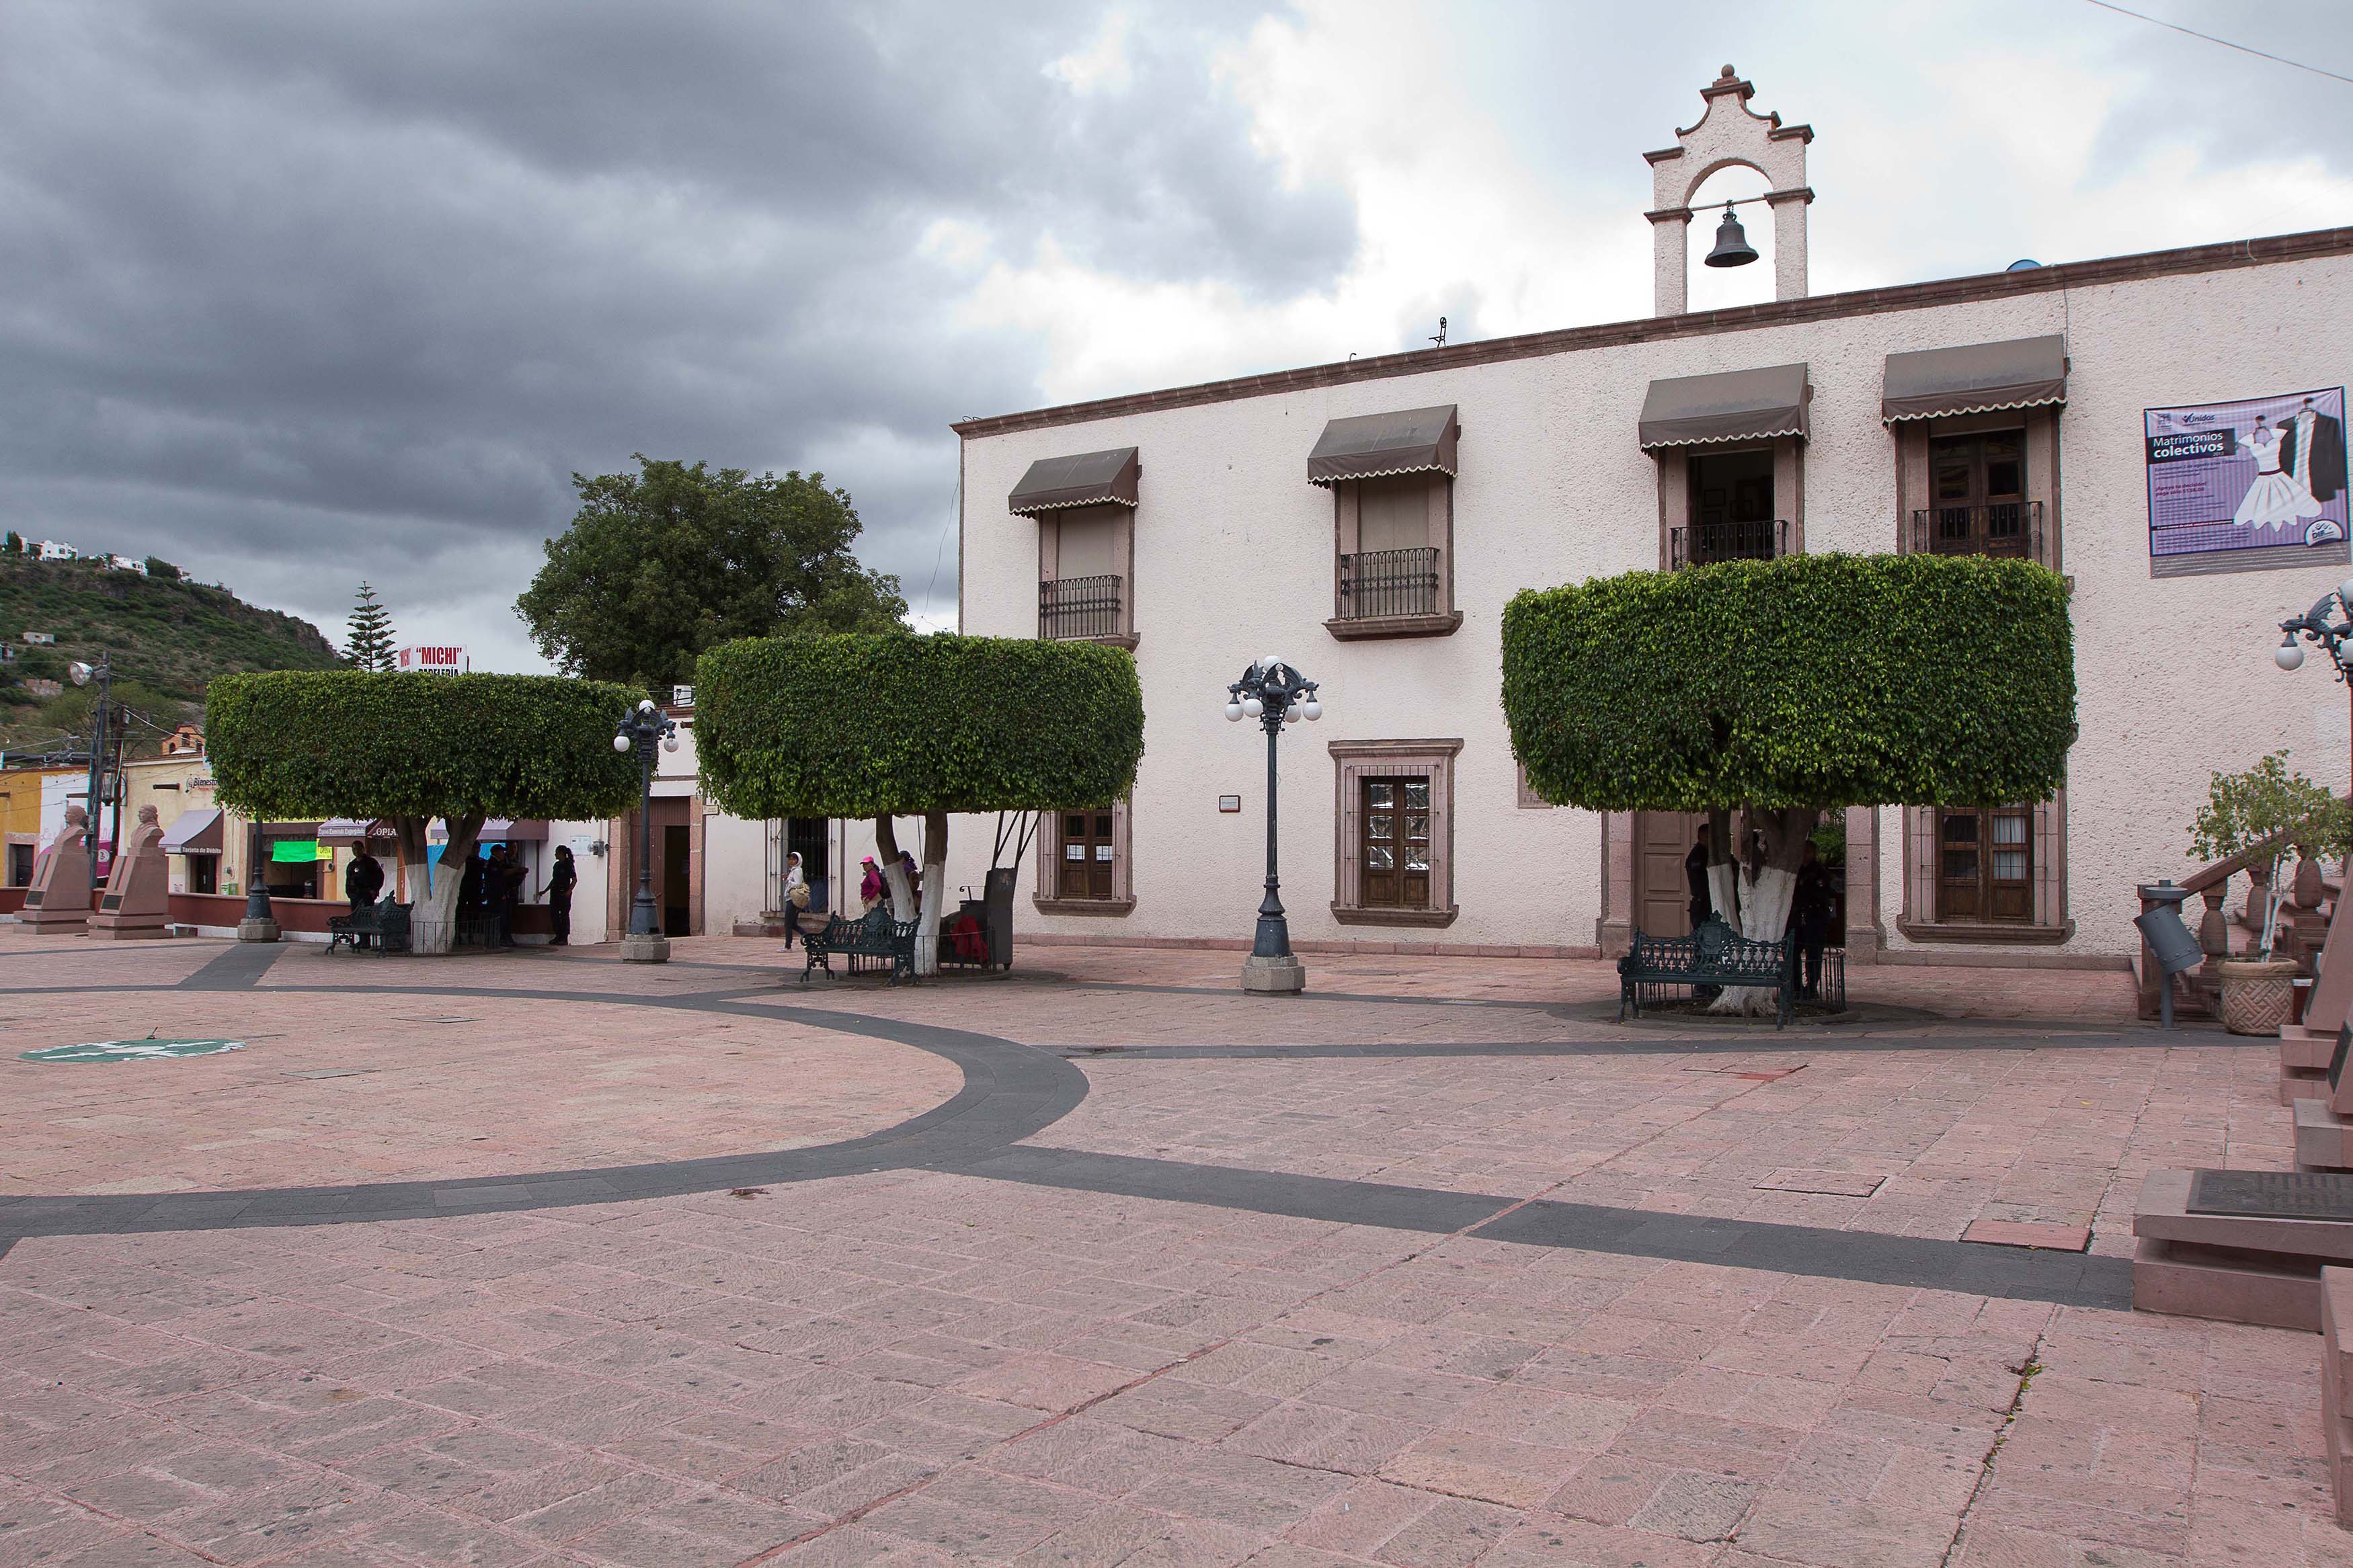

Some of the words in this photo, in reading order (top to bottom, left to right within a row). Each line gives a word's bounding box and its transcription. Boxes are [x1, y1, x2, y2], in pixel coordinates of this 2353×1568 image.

[2188, 413, 2215, 423] Unidos
[2153, 432, 2223, 447] Matrimonios
[2153, 442, 2225, 458] colectivos
[2312, 530, 2325, 539] DIF
